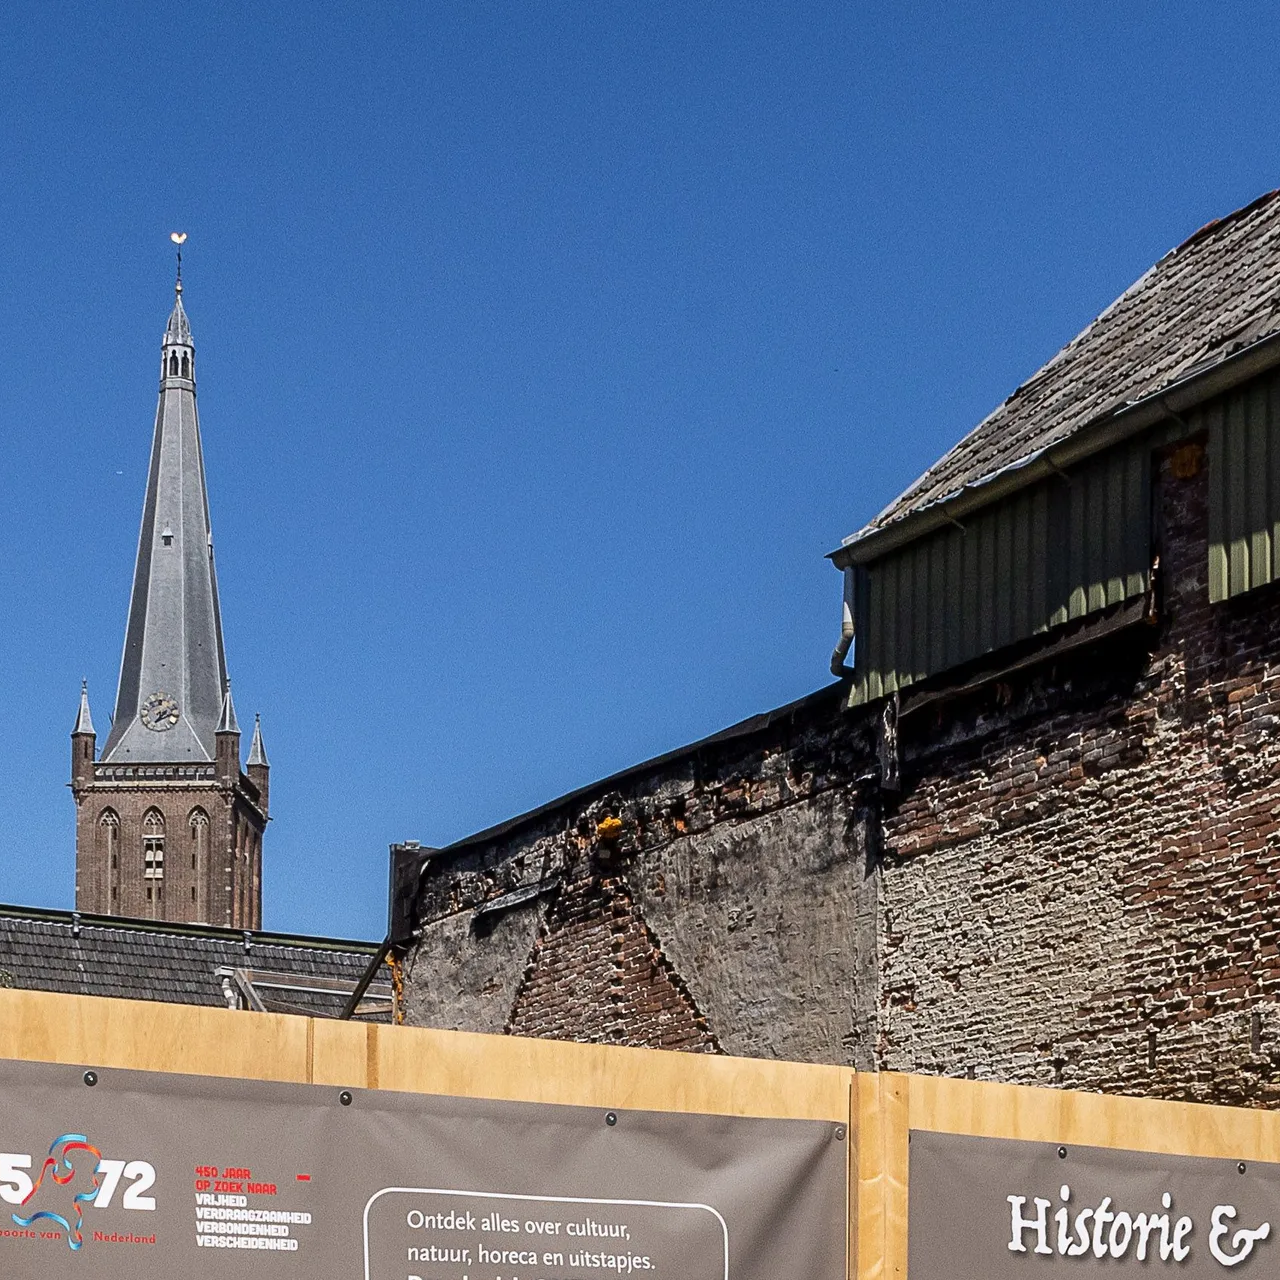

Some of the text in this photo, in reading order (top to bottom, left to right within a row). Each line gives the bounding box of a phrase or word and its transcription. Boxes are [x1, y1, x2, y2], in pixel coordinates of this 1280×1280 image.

[195, 1166, 251, 1180] 450 JAAR
[93, 1158, 156, 1211] 72
[195, 1179, 277, 1195] OP ZOEK NAAR
[195, 1193, 247, 1207] VRIJHEID
[195, 1207, 312, 1224] VERDRAAGZAAMHEID
[195, 1221, 289, 1237] VERBONDENHEID
[407, 1210, 630, 1241] Ontdek alles over cultuur,
[1006, 1184, 1193, 1263] Historie
[1208, 1204, 1270, 1267] &
[39, 1229, 61, 1241] van
[93, 1231, 156, 1245] Nederland
[195, 1235, 298, 1251] VERSCHEIDENHEID
[408, 1243, 656, 1274] natuur, horeca en uitstapjes.
